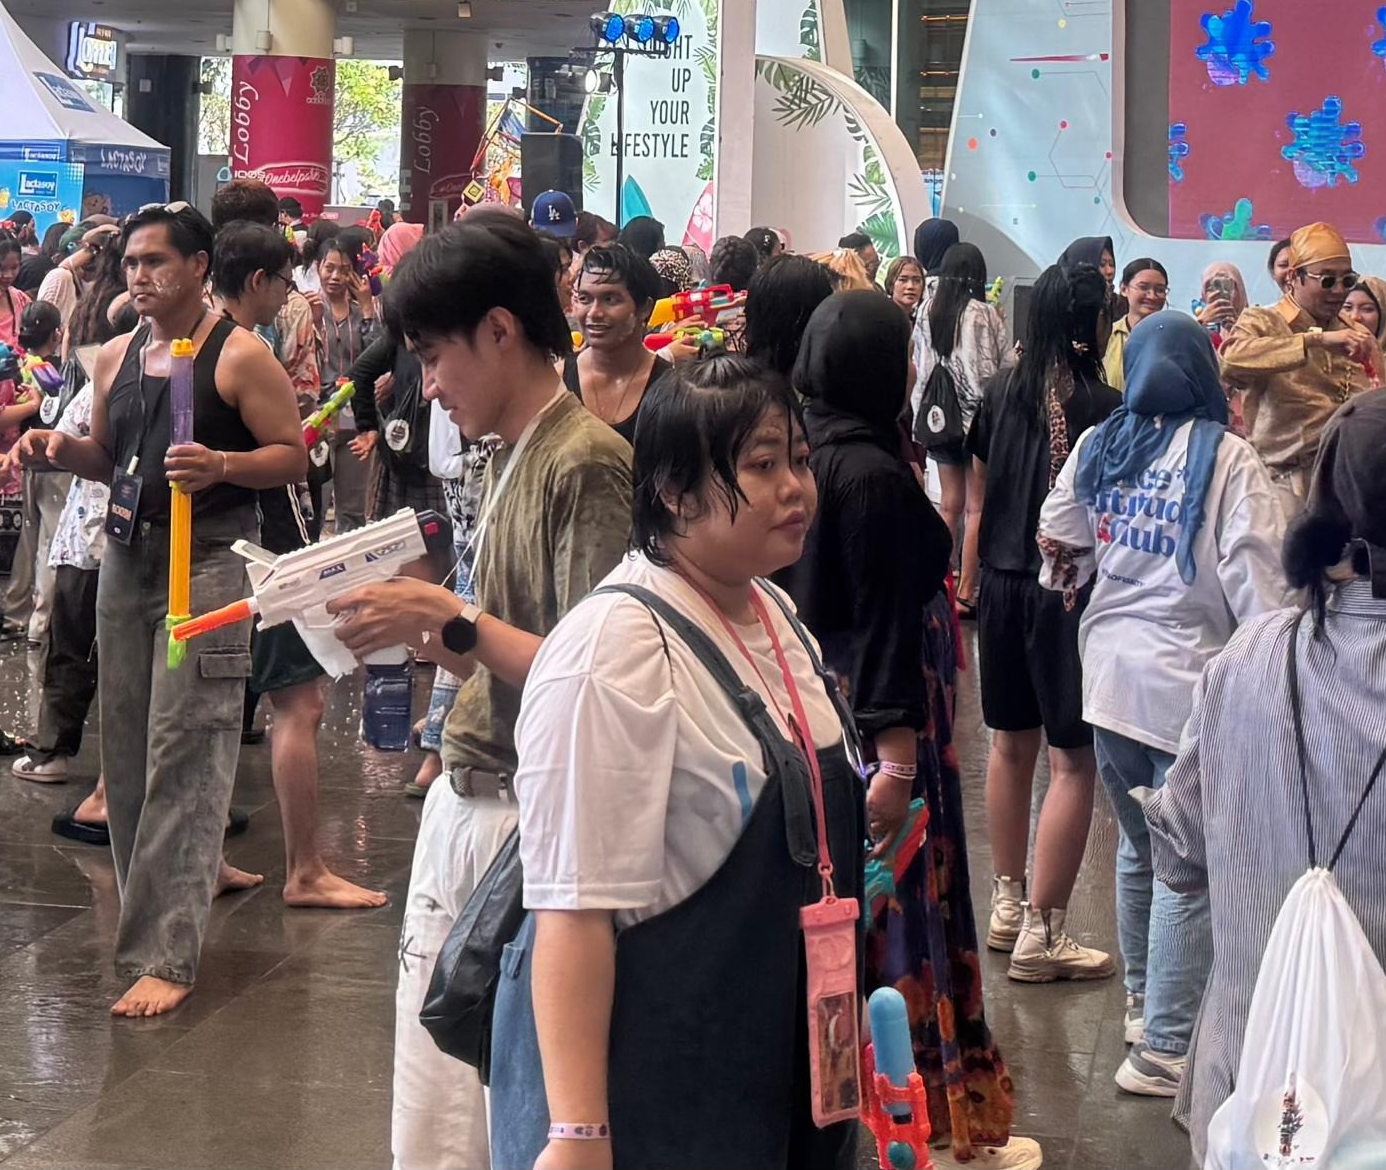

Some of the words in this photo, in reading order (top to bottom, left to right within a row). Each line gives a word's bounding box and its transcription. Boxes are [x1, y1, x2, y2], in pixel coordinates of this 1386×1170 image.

[671, 68, 692, 93] UP
[233, 81, 259, 166] Lobby
[650, 100, 690, 125] YOUR
[414, 106, 440, 174] Lobby
[610, 133, 689, 158] LFESTYLE
[100, 148, 147, 173] LACTASOY
[19, 173, 56, 194] Lactasoy
